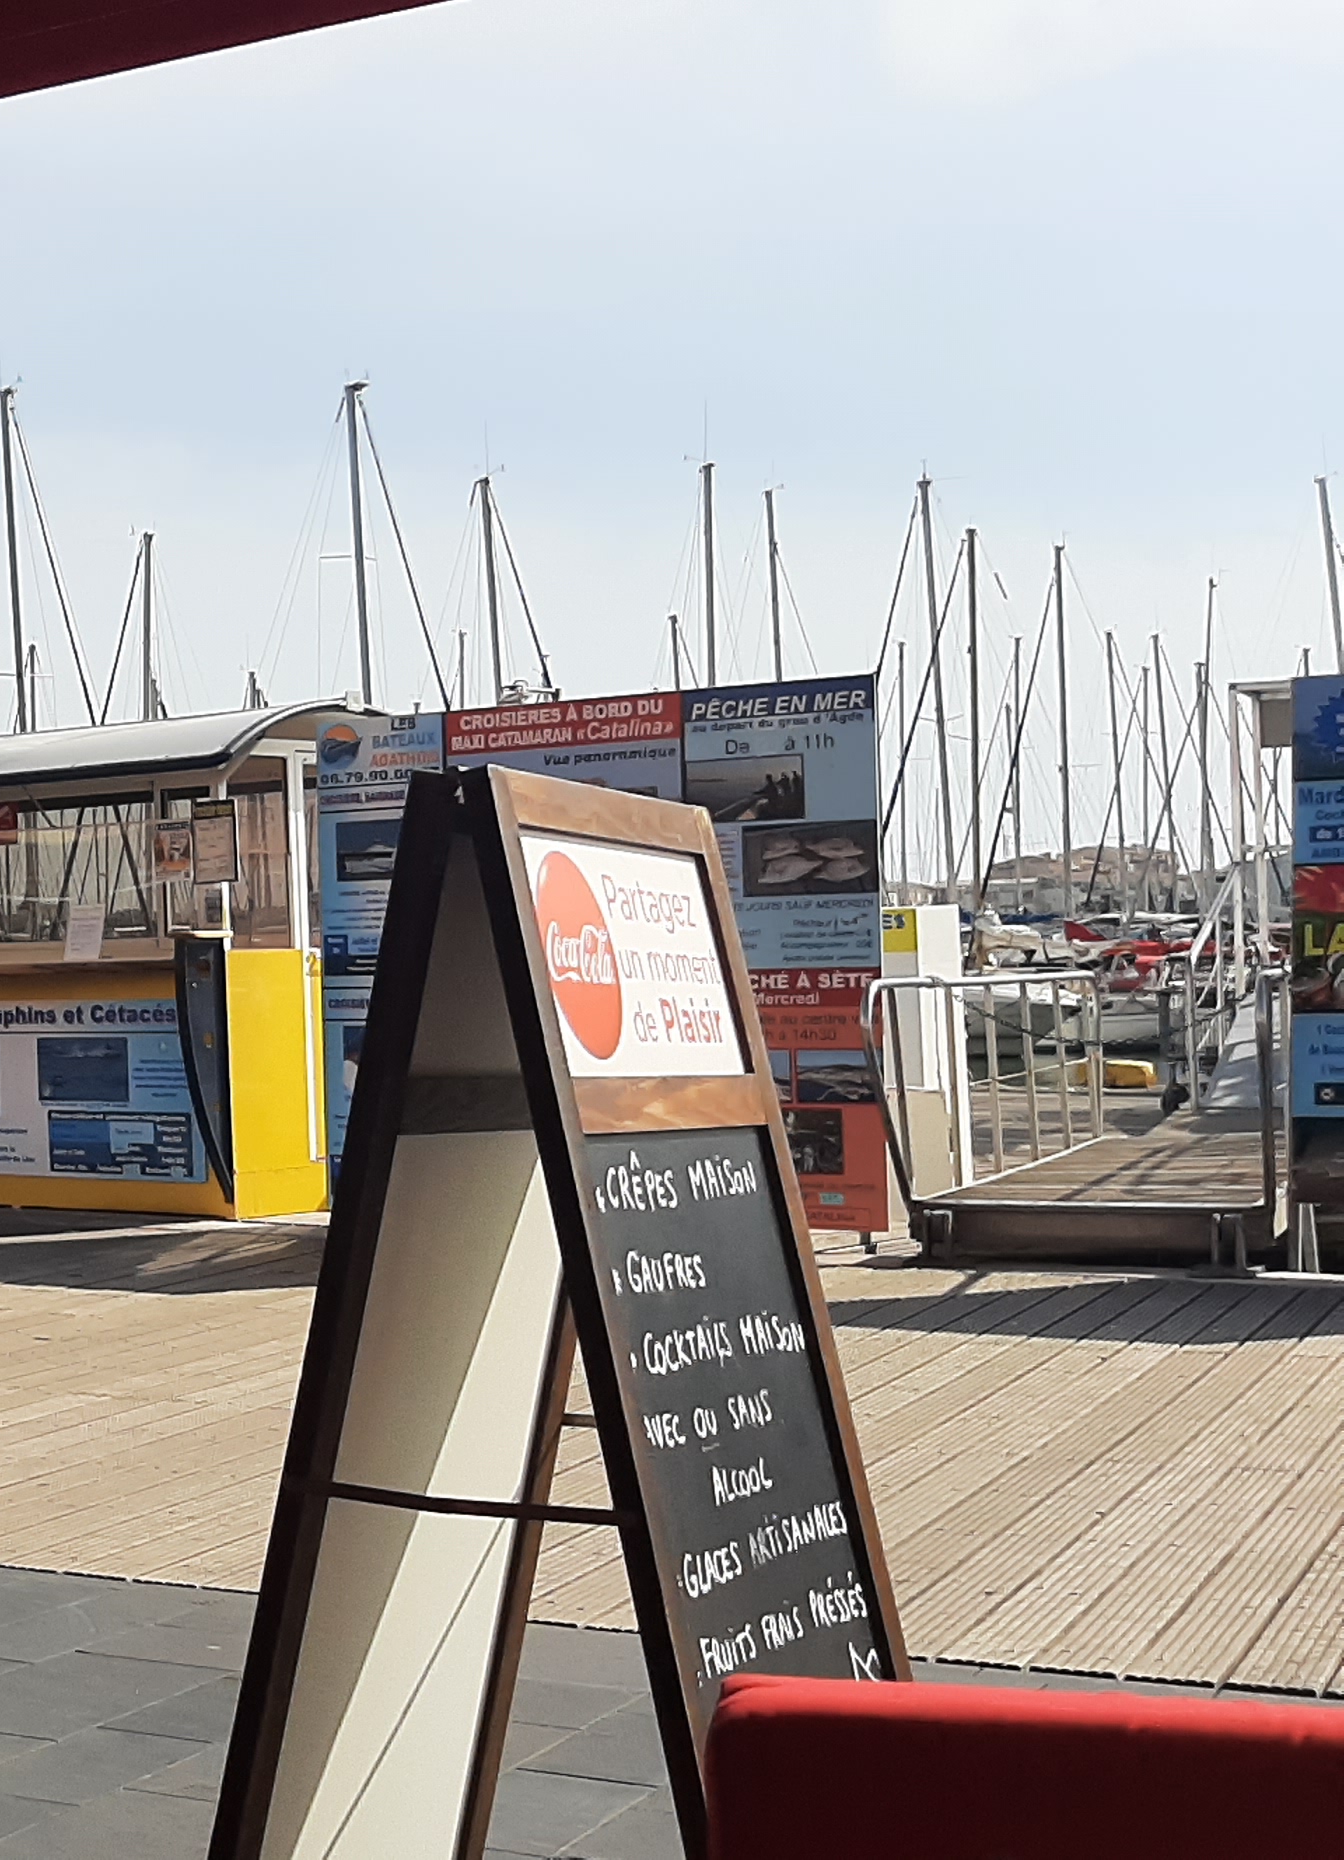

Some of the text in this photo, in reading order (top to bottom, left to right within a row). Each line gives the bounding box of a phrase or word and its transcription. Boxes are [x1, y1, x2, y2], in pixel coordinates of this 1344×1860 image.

[460, 698, 663, 730] CROISIÈRES À BORD DU
[692, 690, 866, 721] PÊCHE EN MER
[372, 732, 435, 749] BATEAUX
[451, 732, 485, 750] MAXI
[488, 726, 572, 748] CATAMARAN
[544, 747, 676, 766] Vue panoramique
[725, 733, 834, 755] De à 11h
[601, 874, 696, 934] Partagez
[618, 949, 721, 984] un moment
[797, 968, 811, 988] À
[63, 1005, 85, 1024] et
[633, 996, 723, 1044] de Plaisir
[605, 1151, 757, 1213] CRÊPES MAISON
[626, 1249, 707, 1296] GAUFRES
[643, 1310, 806, 1376] COCKTAILS MAISON
[643, 1388, 773, 1450] AVEC OU SANS
[712, 1456, 774, 1507] ALCOOL
[683, 1500, 848, 1599] GLACES ARTISANALES
[700, 1621, 756, 1679] FRUITS
[760, 1602, 805, 1651] FRAIS
